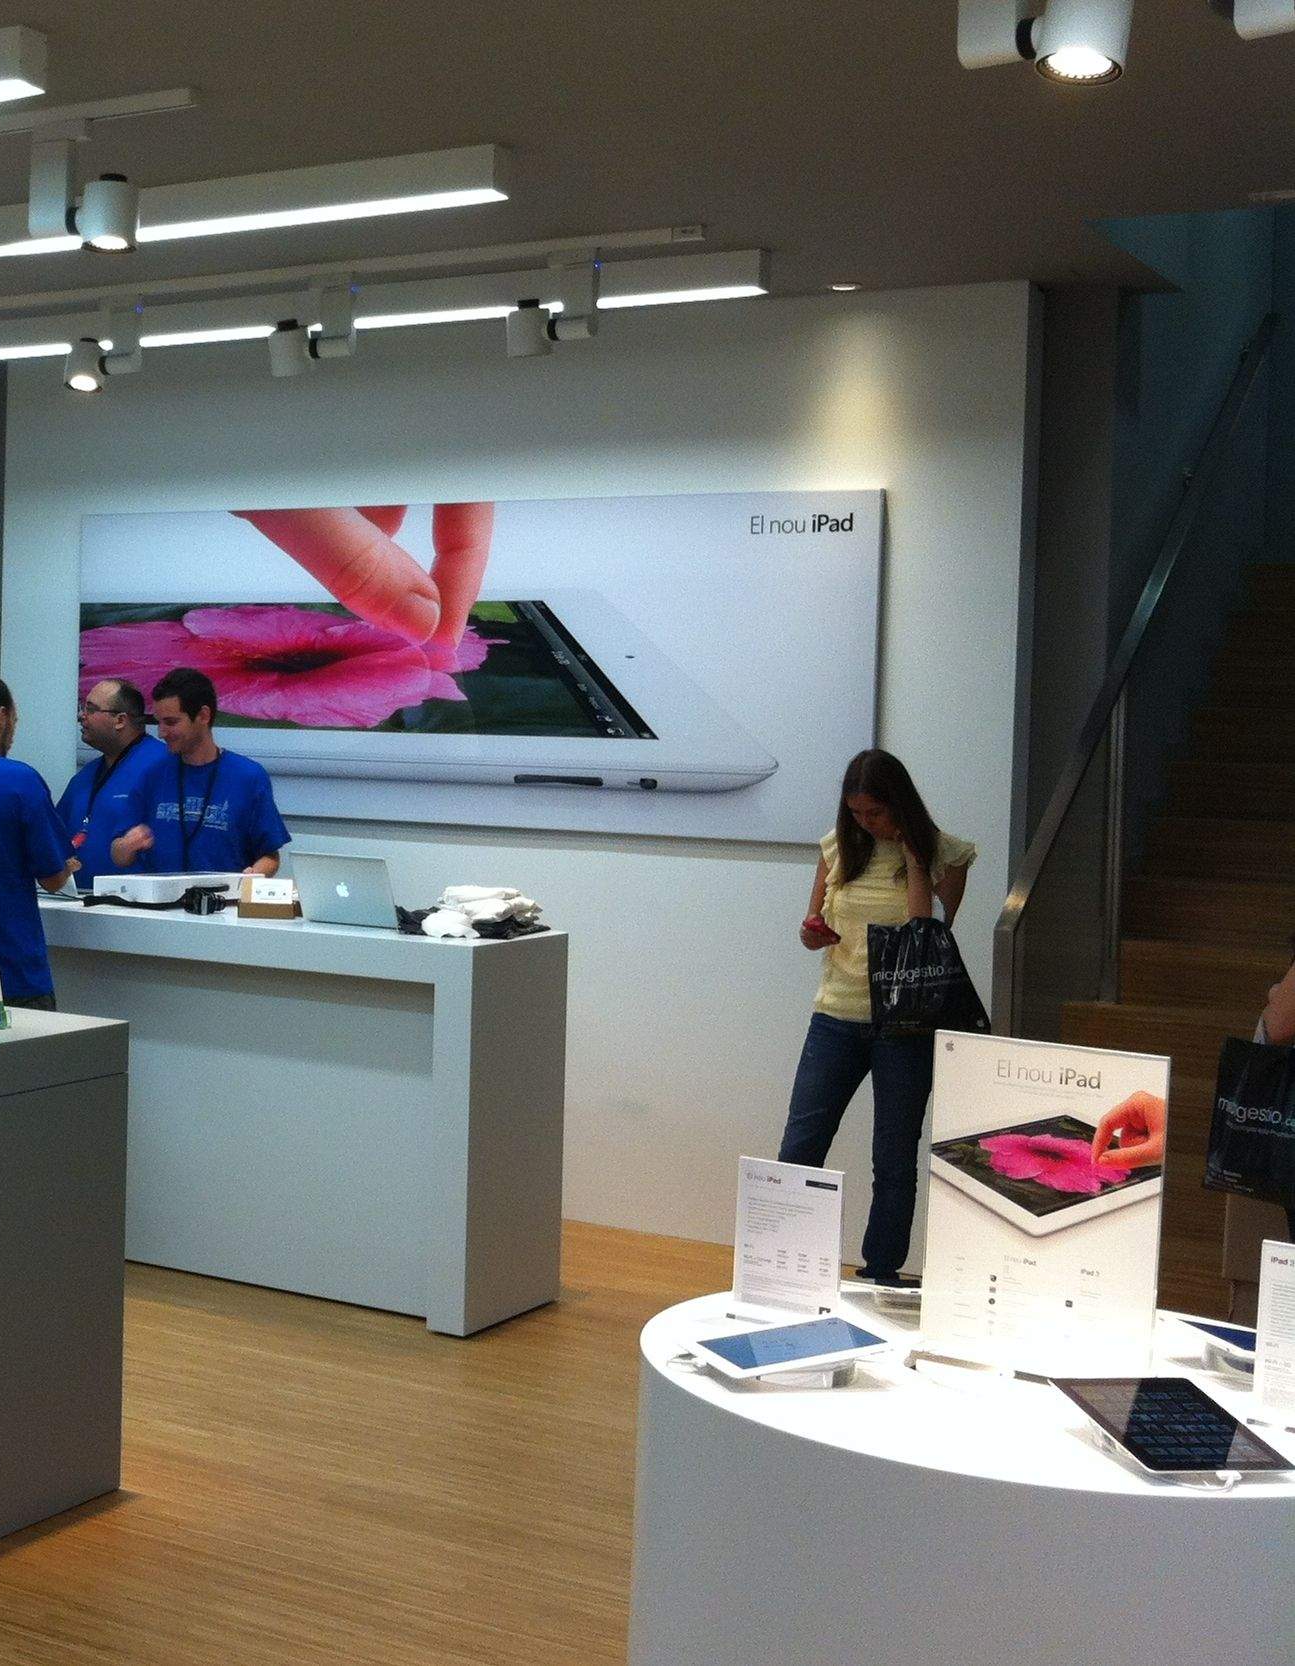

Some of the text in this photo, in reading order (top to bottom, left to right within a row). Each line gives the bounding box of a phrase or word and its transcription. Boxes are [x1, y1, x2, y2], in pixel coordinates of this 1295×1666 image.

[750, 512, 854, 535] El nou iPad
[997, 1060, 1102, 1090] El nou iPad
[1271, 1256, 1288, 1265] iPad
